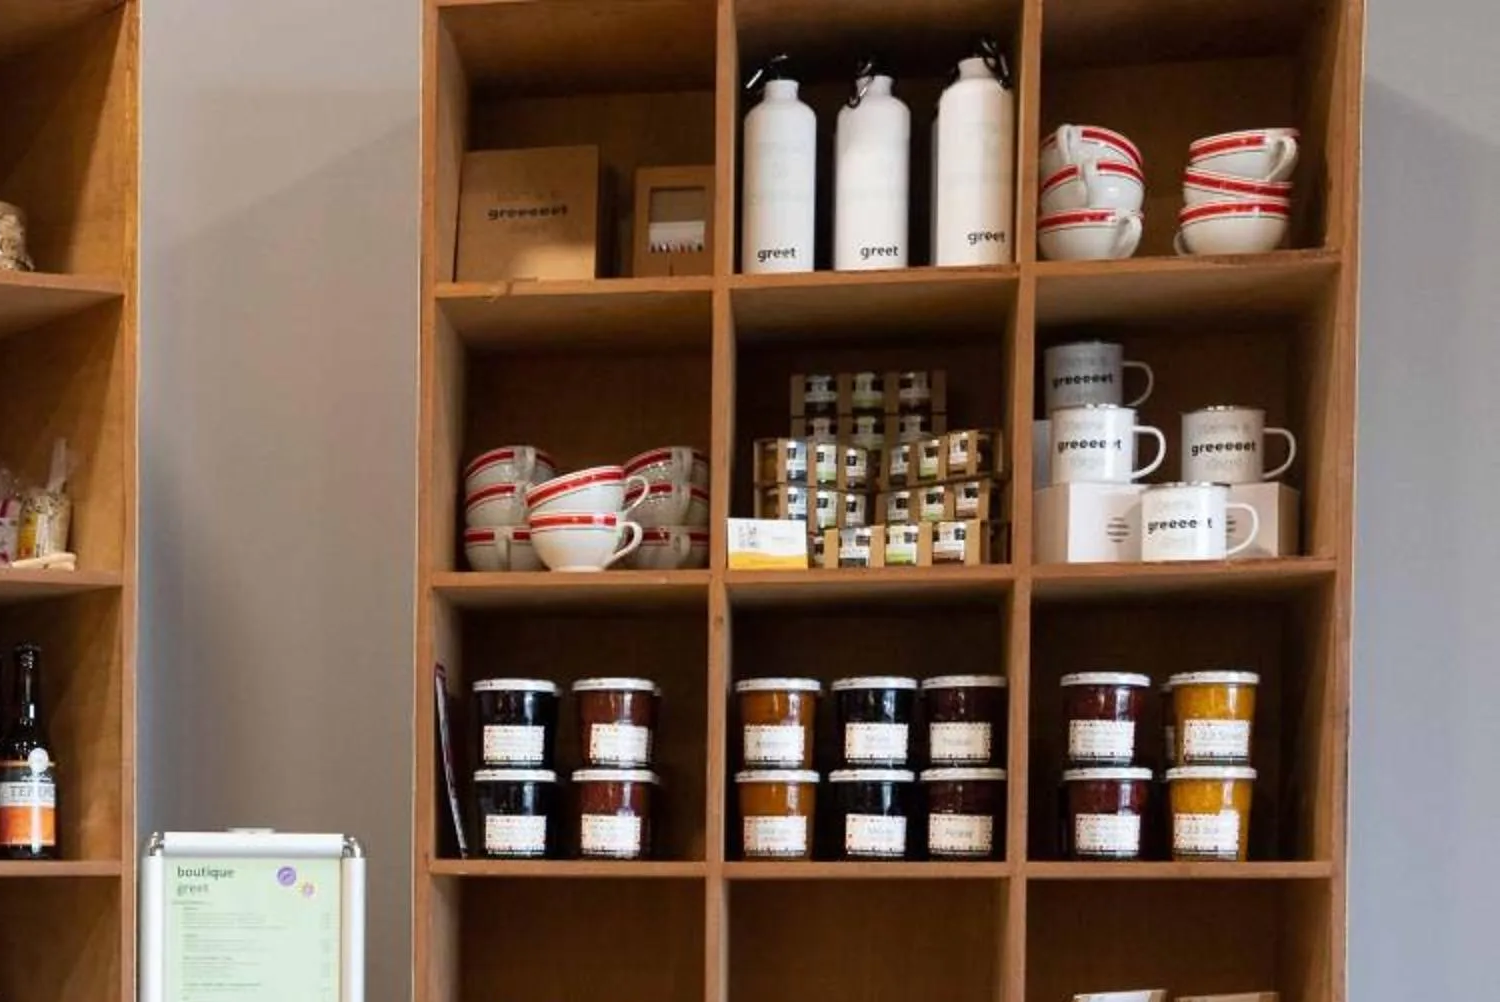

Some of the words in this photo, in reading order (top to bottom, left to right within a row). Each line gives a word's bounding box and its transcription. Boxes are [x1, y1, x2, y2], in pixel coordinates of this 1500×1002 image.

[967, 230, 1006, 244] greet
[757, 247, 796, 262] greet
[860, 246, 899, 261] greet
[177, 865, 235, 881] boutique
